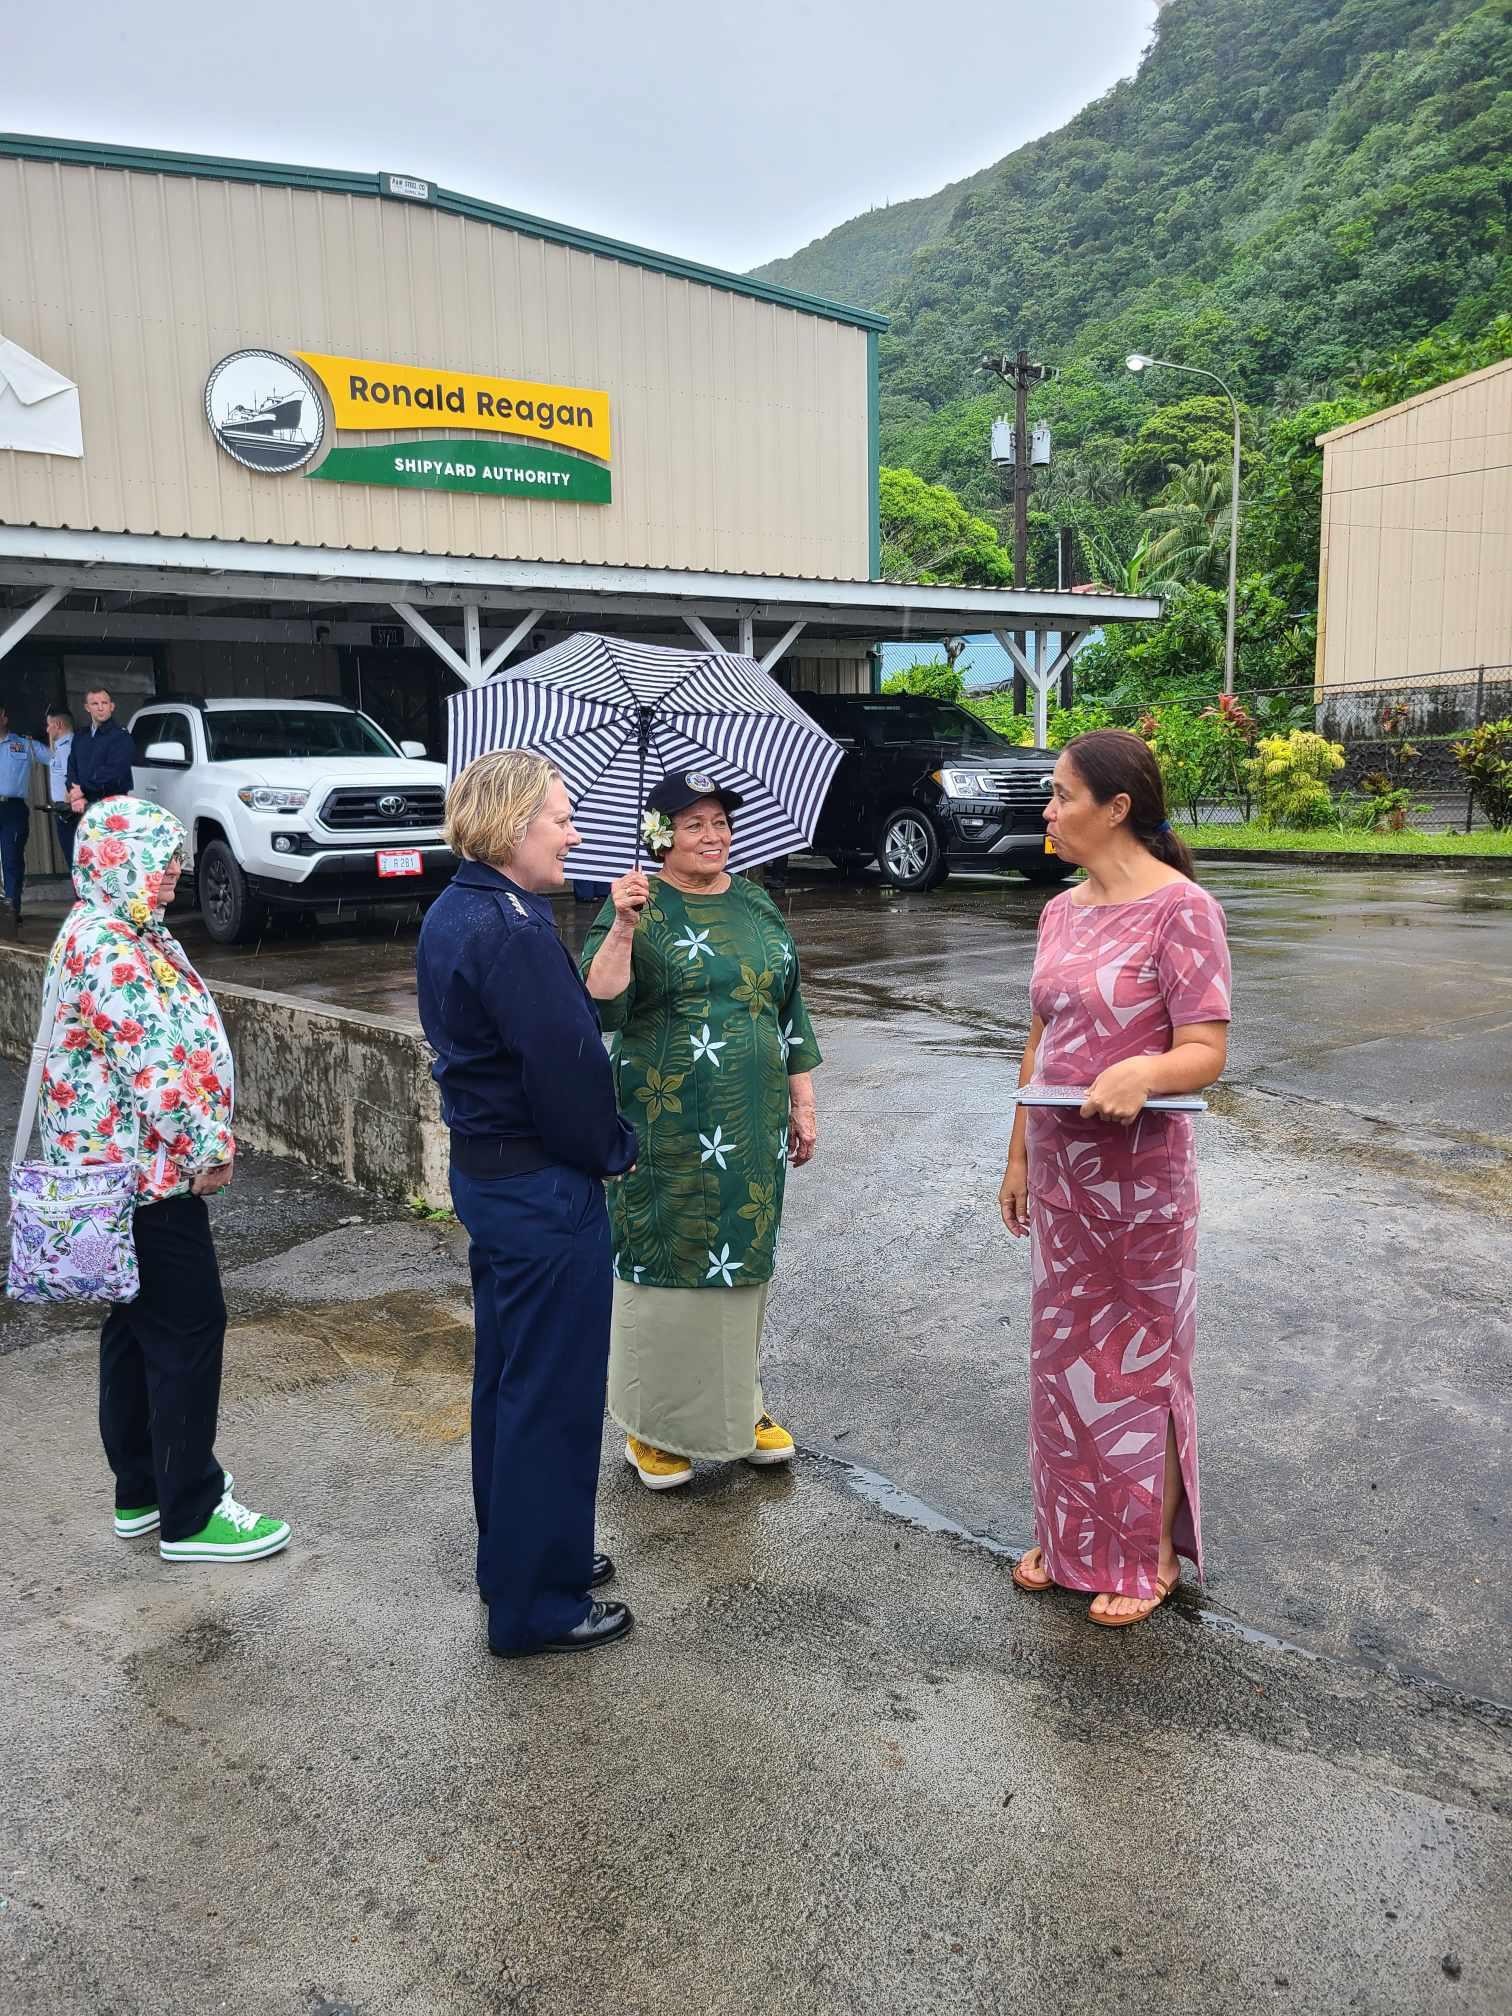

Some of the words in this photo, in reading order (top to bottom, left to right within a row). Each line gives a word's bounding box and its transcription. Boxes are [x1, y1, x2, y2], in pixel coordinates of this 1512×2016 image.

[349, 375, 465, 414] Ronald
[477, 391, 593, 430] Reagan
[394, 457, 476, 478] SHIPYARD
[482, 466, 571, 486] AUTHORITY
